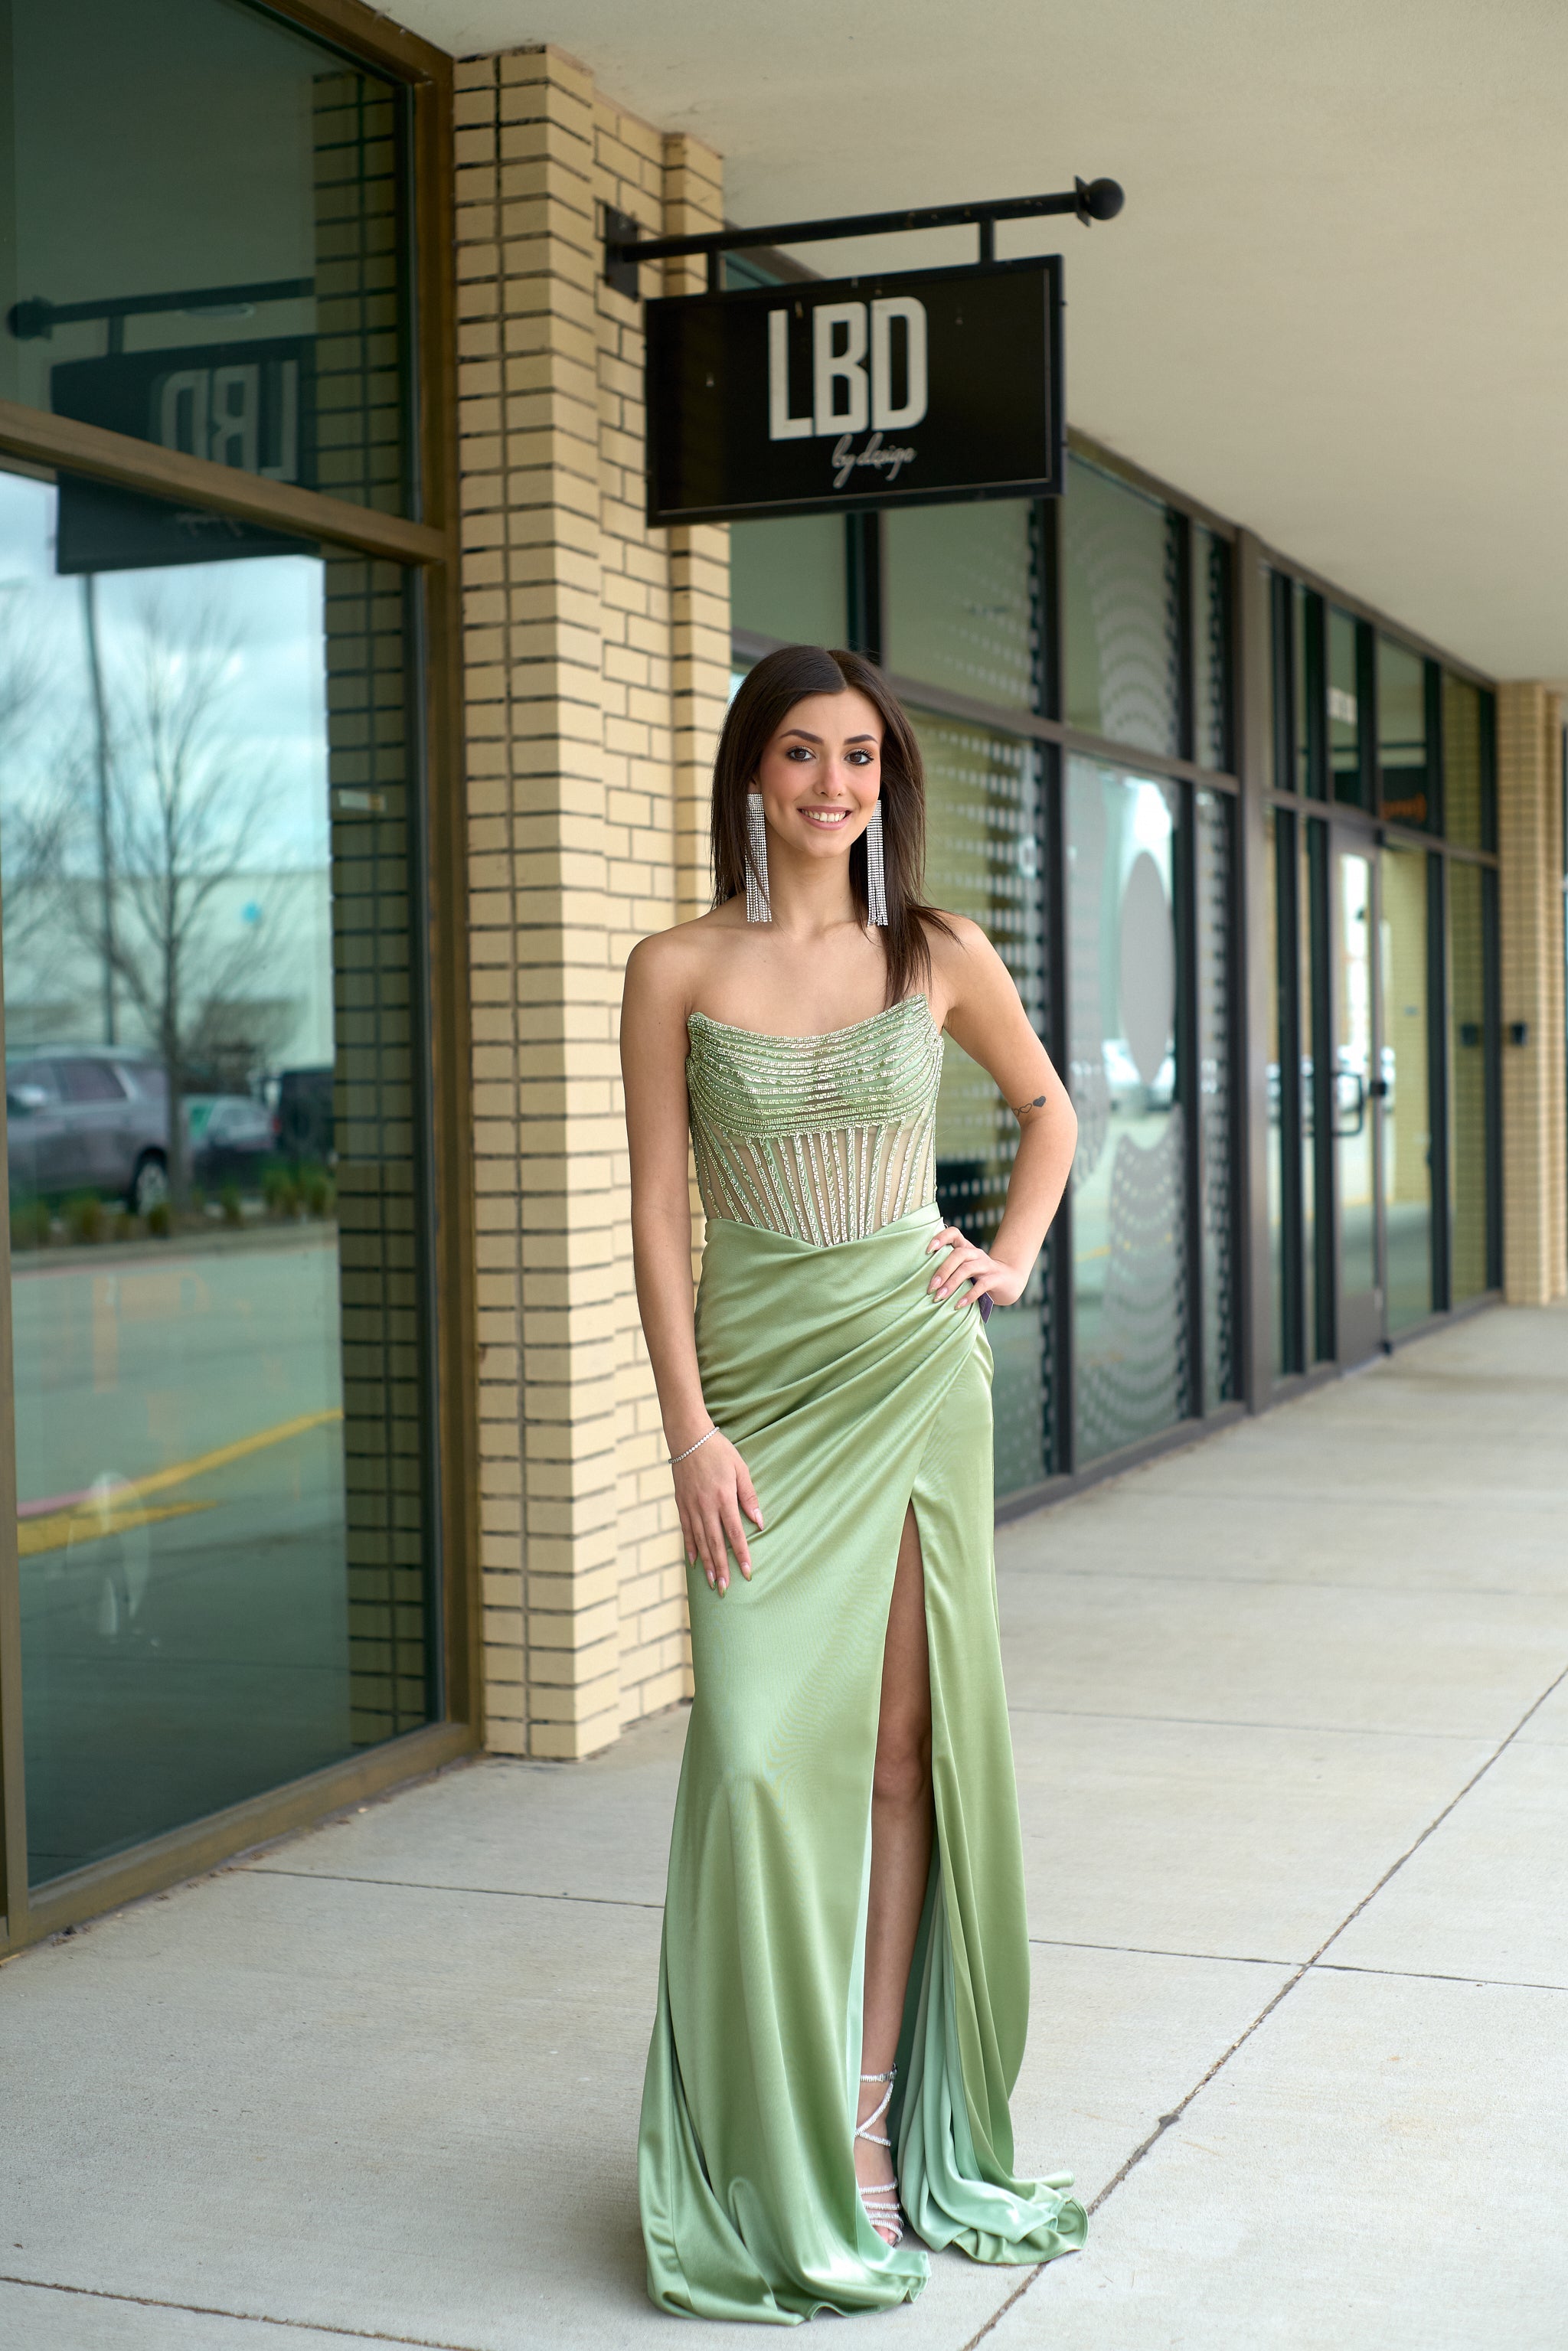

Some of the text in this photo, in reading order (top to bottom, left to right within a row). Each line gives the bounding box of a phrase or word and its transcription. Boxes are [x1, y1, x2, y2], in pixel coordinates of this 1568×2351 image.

[769, 296, 928, 440] LBD
[831, 432, 916, 488] by design
